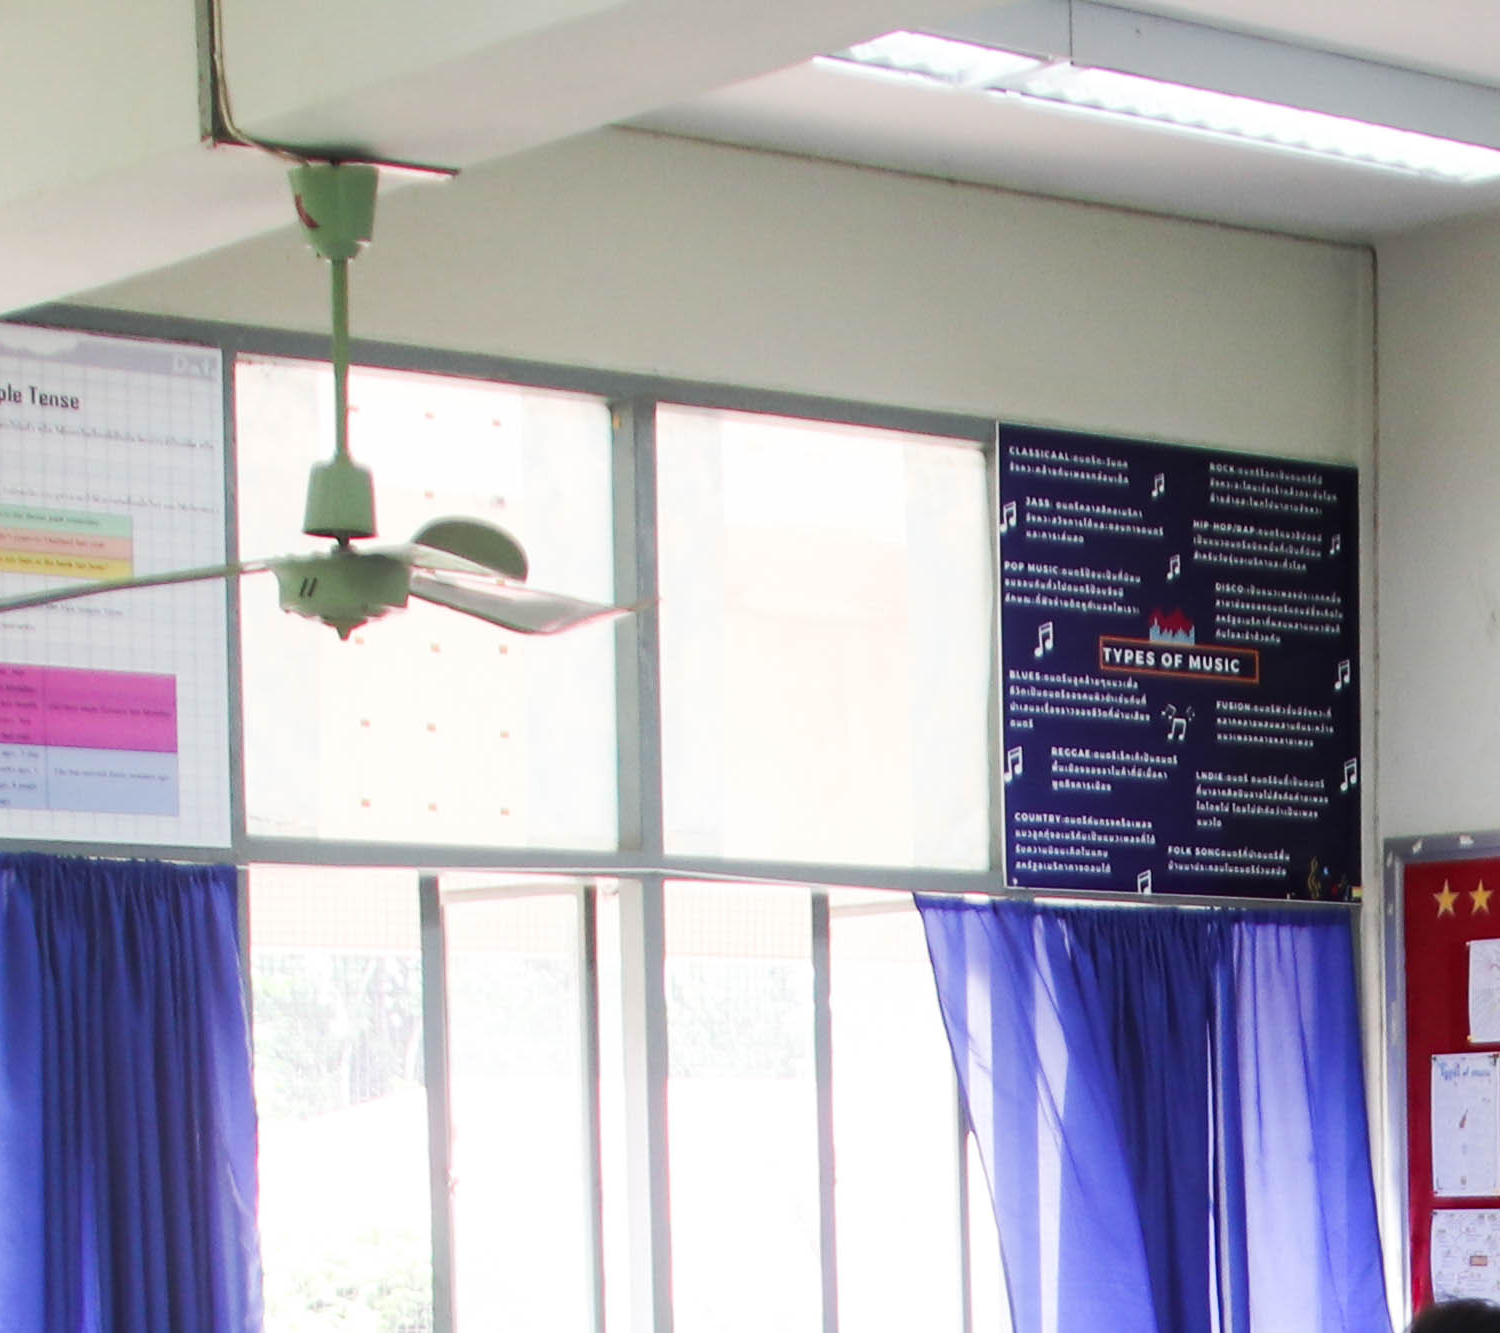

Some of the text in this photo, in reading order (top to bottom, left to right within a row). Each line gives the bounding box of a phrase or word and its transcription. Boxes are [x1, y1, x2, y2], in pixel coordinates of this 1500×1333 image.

[29, 386, 80, 410] Tense
[1102, 647, 1241, 674] TYPES OF MUSIC
